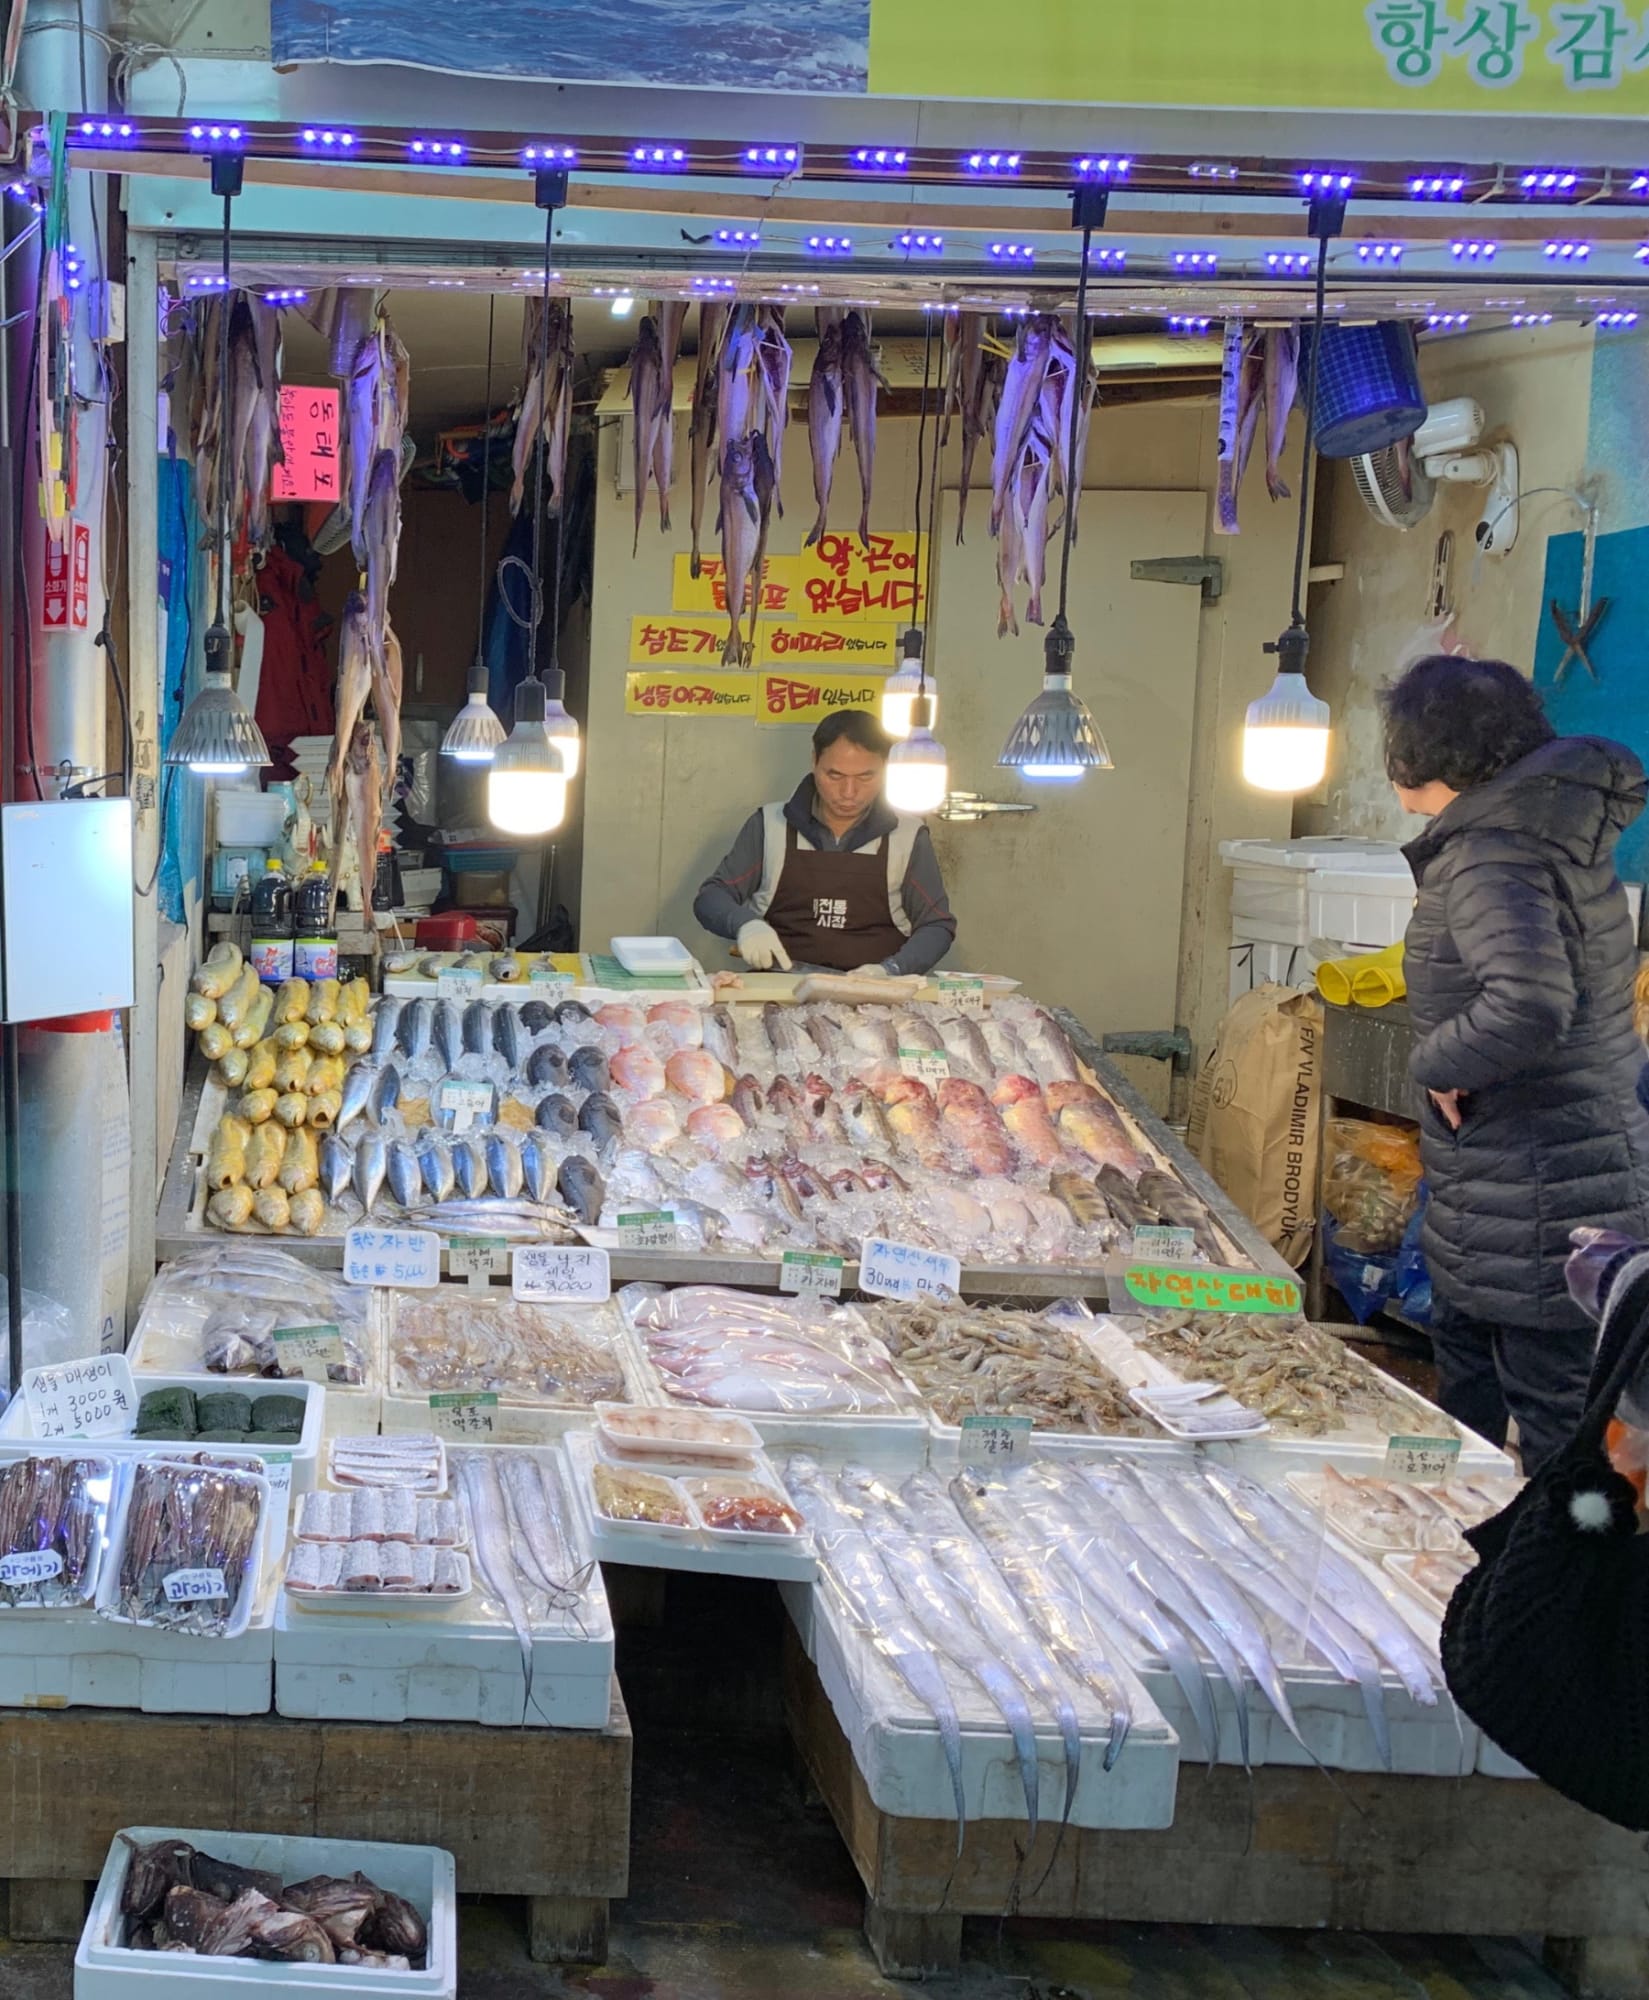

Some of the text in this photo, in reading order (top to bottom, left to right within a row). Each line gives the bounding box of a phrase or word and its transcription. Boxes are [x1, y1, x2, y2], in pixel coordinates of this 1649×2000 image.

[1375, 1, 1649, 82] 항상 감
[309, 400, 335, 492] 동태포
[45, 579, 67, 592] 소화기
[805, 578, 925, 616] 있습니다
[771, 627, 845, 654] 해파리
[846, 638, 887, 651] 있습니다
[634, 684, 752, 709] 냉동아귀 있습니다
[766, 677, 875, 714] 동태 있습니다
[819, 898, 848, 915] 전통
[816, 914, 847, 929] 시장
[1280, 1026, 1315, 1241] F/V VLADIMIR BRODYUK
[379, 1232, 426, 1253] 자반
[872, 1242, 920, 1266] 자연산
[558, 1252, 591, 1269] 낙지
[800, 1275, 839, 1290] 가자미
[32, 1361, 112, 1394] 생물 매생이
[68, 1388, 108, 1412] 3000
[112, 1388, 129, 1411] 원
[74, 1404, 111, 1429] 5000
[981, 1429, 1011, 1441] 제주
[983, 1440, 1014, 1455] 갈치
[0, 1560, 59, 1581] 과메기
[168, 1580, 228, 1600] 과메기
